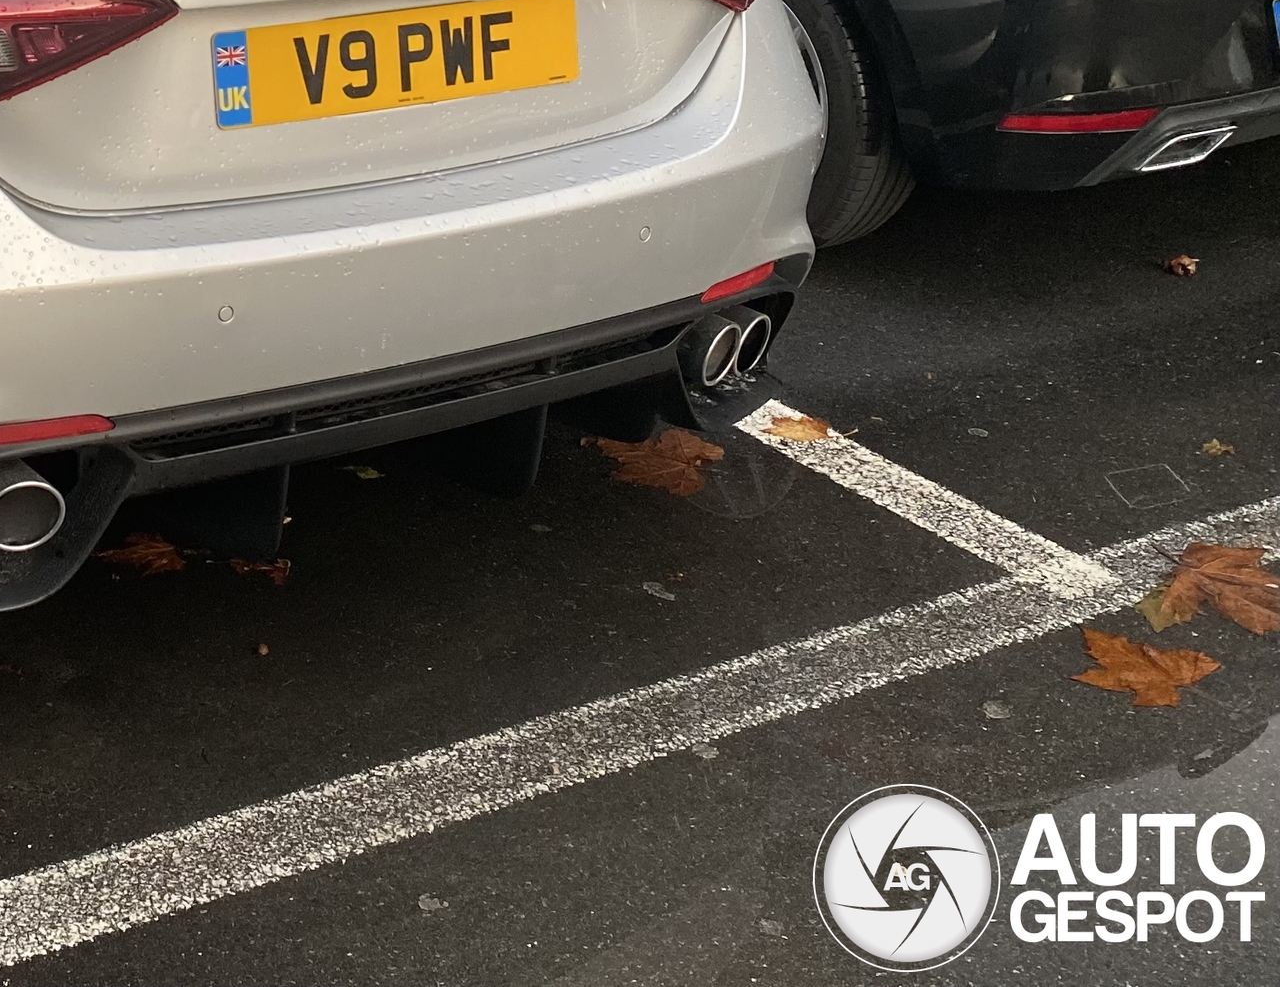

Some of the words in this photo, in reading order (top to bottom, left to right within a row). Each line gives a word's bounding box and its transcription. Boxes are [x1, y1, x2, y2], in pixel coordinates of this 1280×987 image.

[293, 30, 377, 105] V9
[397, 11, 513, 92] PWF
[218, 85, 250, 112] UK
